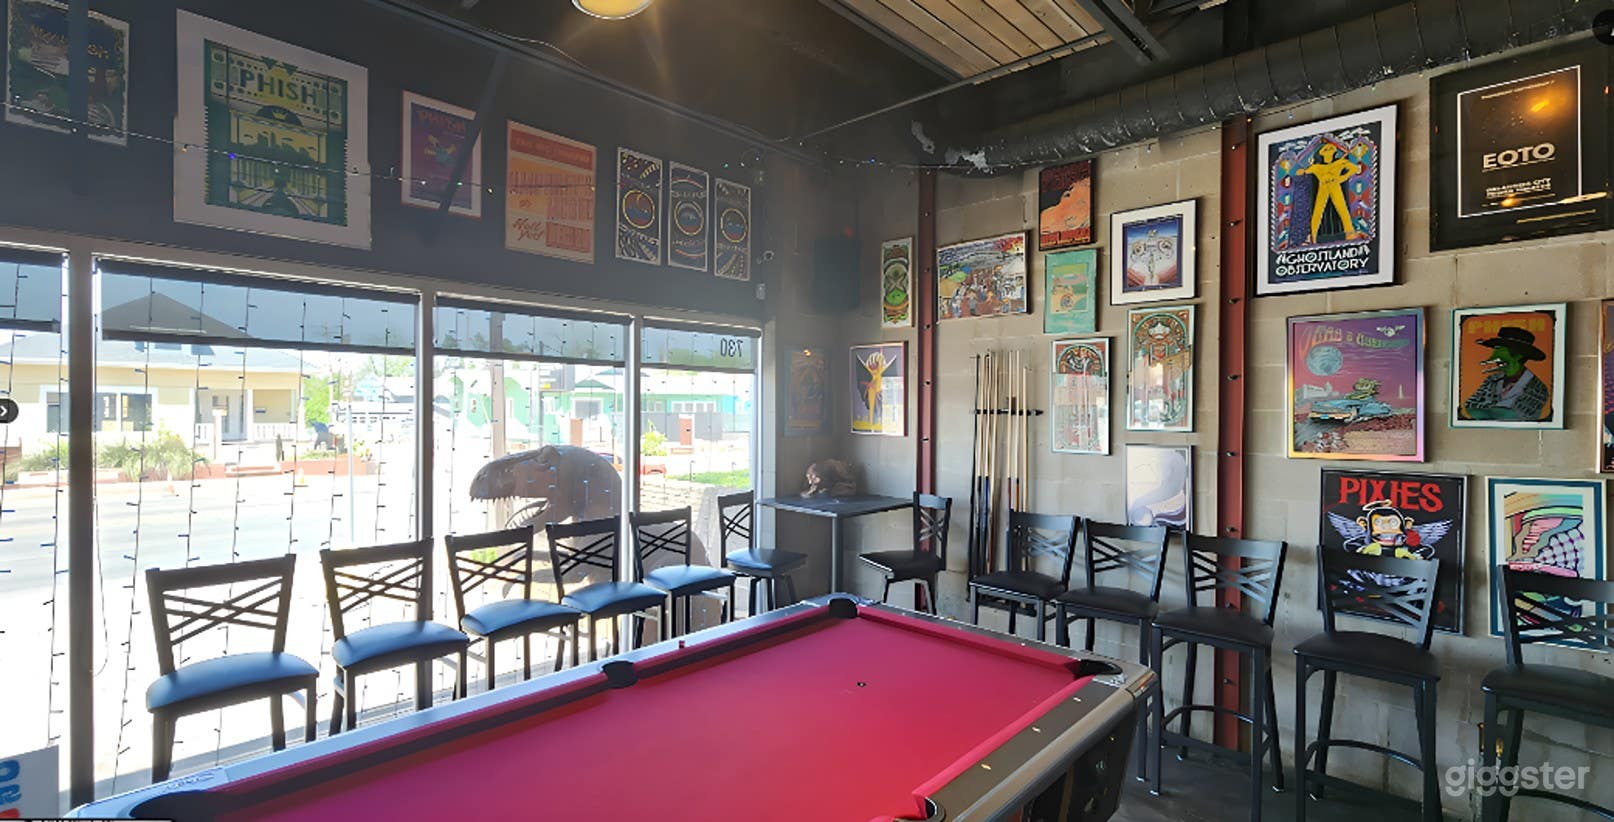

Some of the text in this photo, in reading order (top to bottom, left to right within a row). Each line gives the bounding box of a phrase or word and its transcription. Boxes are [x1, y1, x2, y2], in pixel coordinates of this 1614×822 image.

[239, 68, 317, 105] PHISH
[1483, 142, 1556, 169] EOTO
[1275, 257, 1370, 277] OBSERVATORY
[1338, 476, 1444, 513] PIXIES
